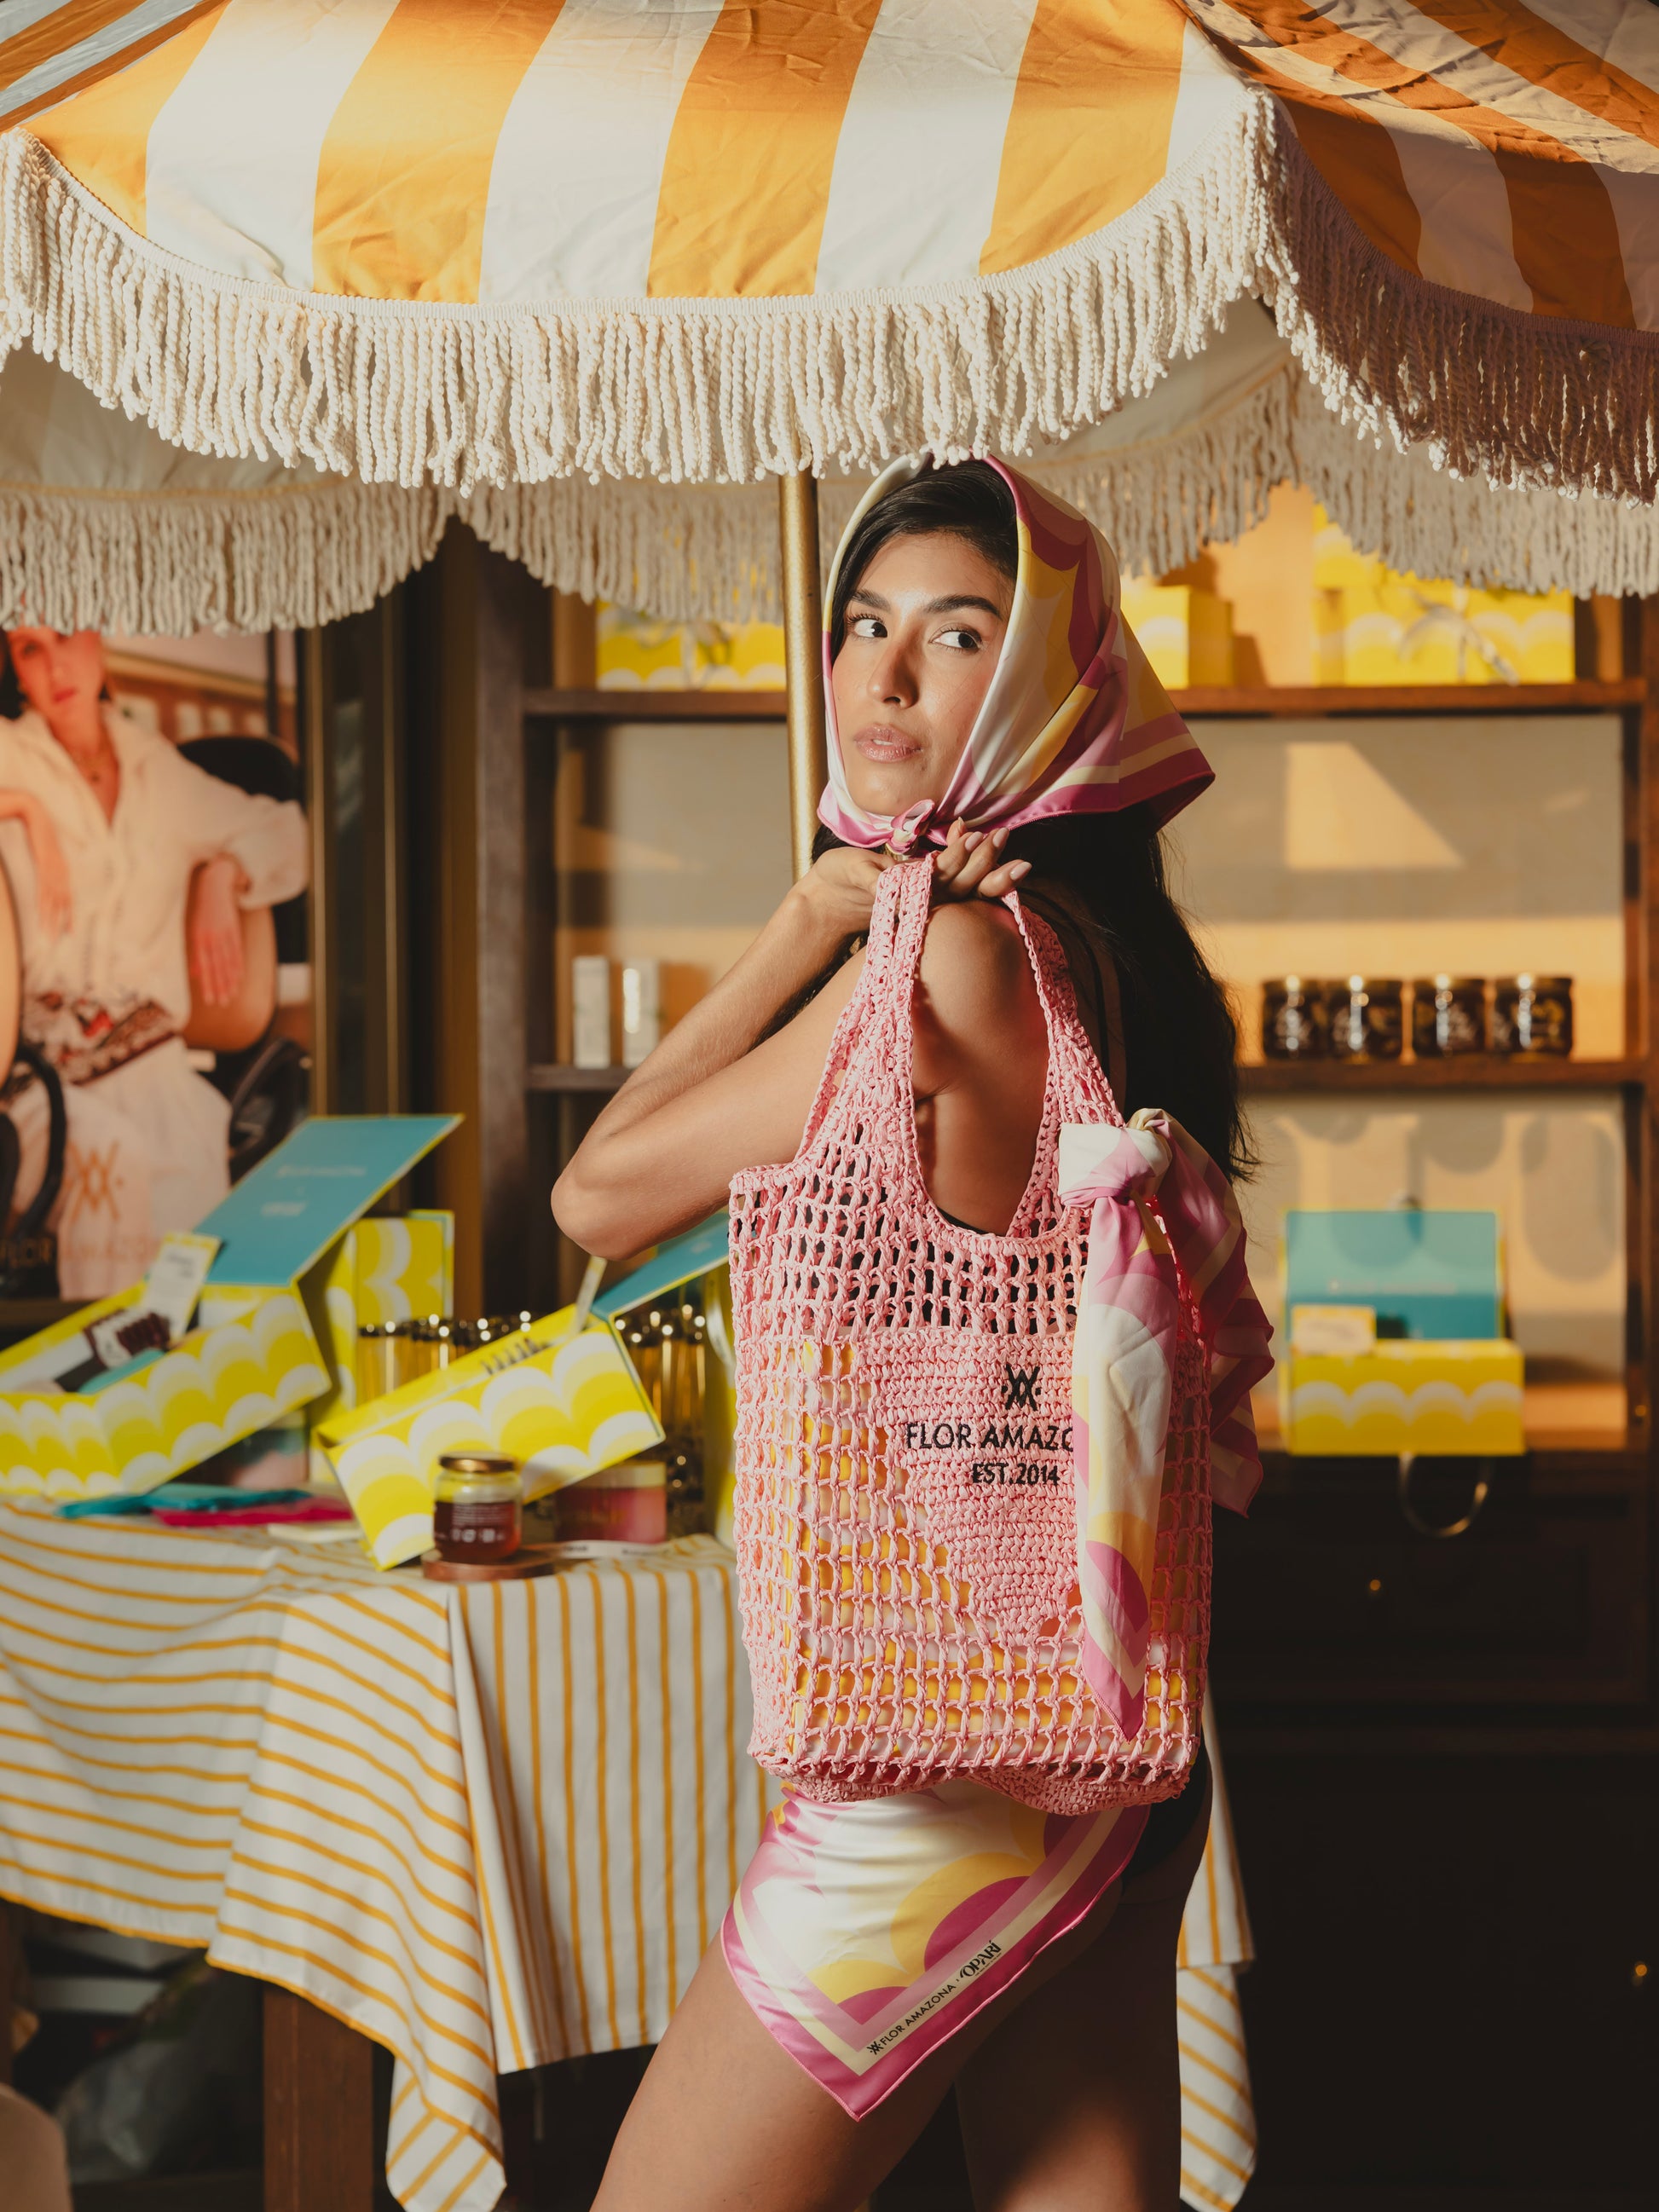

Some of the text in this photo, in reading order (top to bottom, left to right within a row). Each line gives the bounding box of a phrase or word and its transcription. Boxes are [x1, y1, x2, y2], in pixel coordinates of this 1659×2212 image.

[906, 1423, 972, 1449] FLOR
[880, 2024, 905, 2046] FLOR
[905, 1984, 957, 2026] AMAZONA
